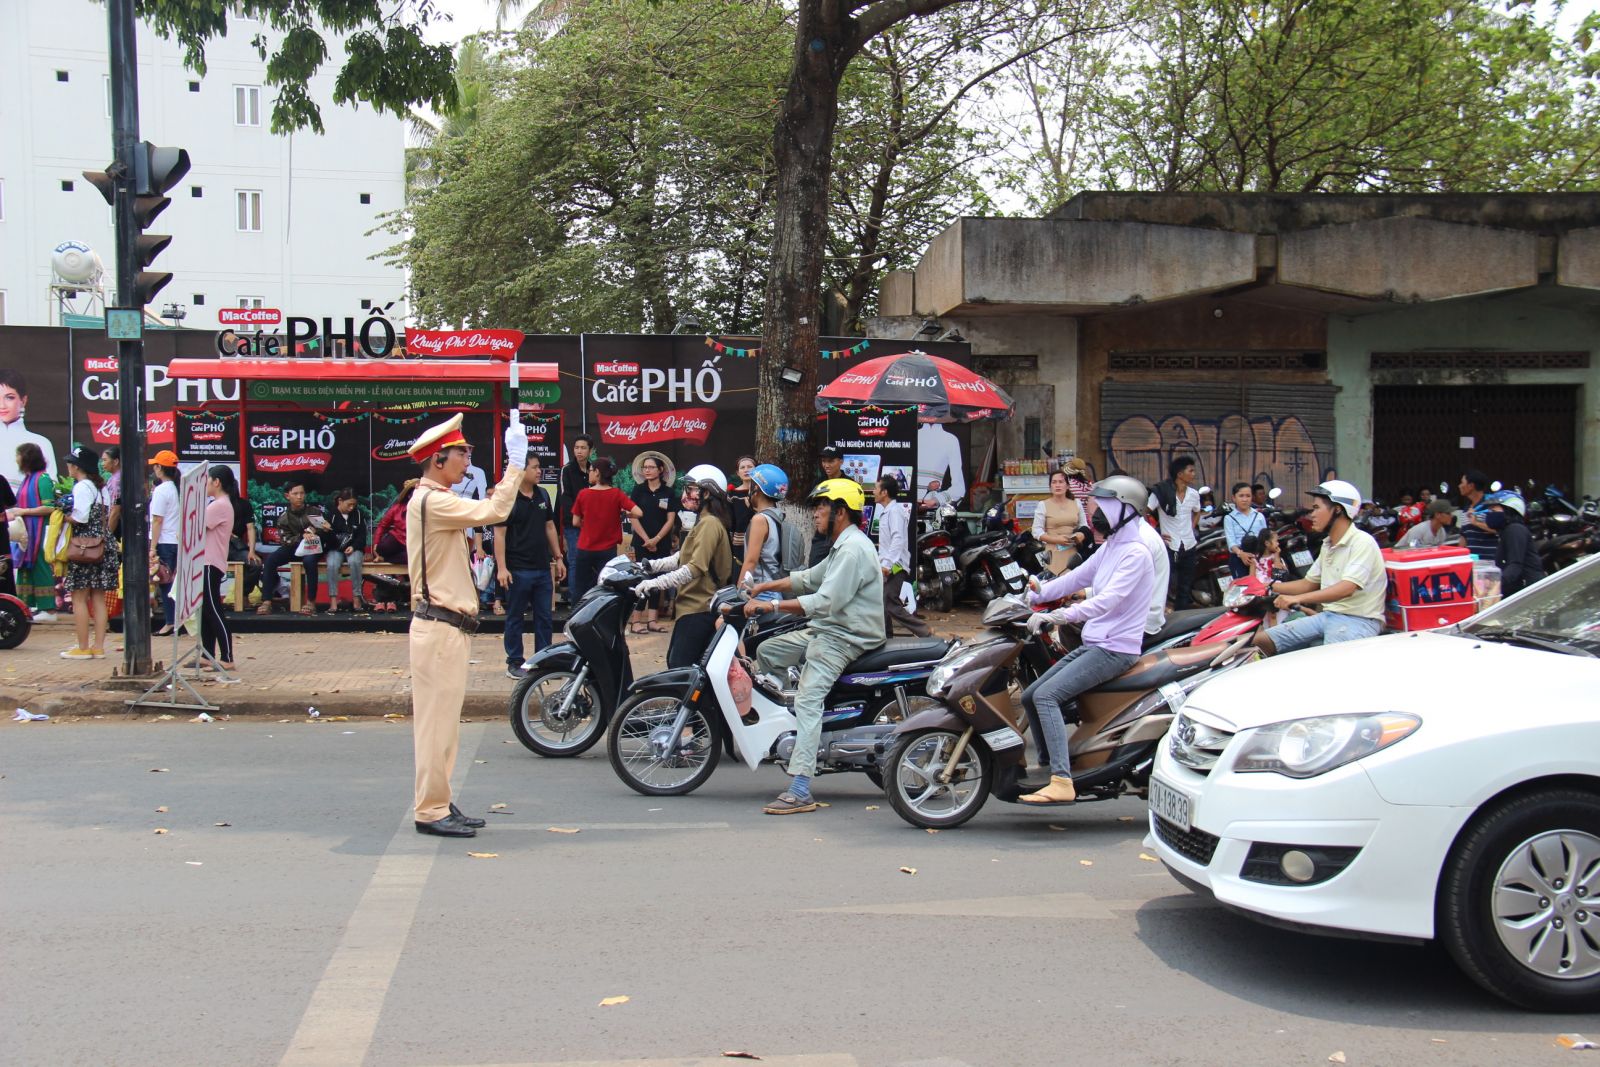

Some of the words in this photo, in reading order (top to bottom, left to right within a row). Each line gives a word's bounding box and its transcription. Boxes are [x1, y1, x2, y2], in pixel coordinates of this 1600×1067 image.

[221, 310, 279, 321] MacCoffee
[217, 328, 280, 356] Café
[286, 302, 396, 358] PHỐ
[596, 364, 638, 373] MacCoffee
[591, 378, 639, 403] Café
[641, 355, 722, 403] PHỐ
[885, 378, 905, 386] Café
[904, 375, 938, 388] PHỐ
[292, 386, 301, 395] XE
[303, 386, 317, 395] BUS
[468, 388, 485, 396] 2019
[203, 421, 226, 432] PHỐ
[869, 415, 890, 427] PHỐ
[526, 423, 547, 434] PHỐ
[250, 434, 281, 449] Café
[282, 422, 336, 450] PHỐ
[902, 441, 911, 449] HAI
[1410, 571, 1473, 605] KEM
